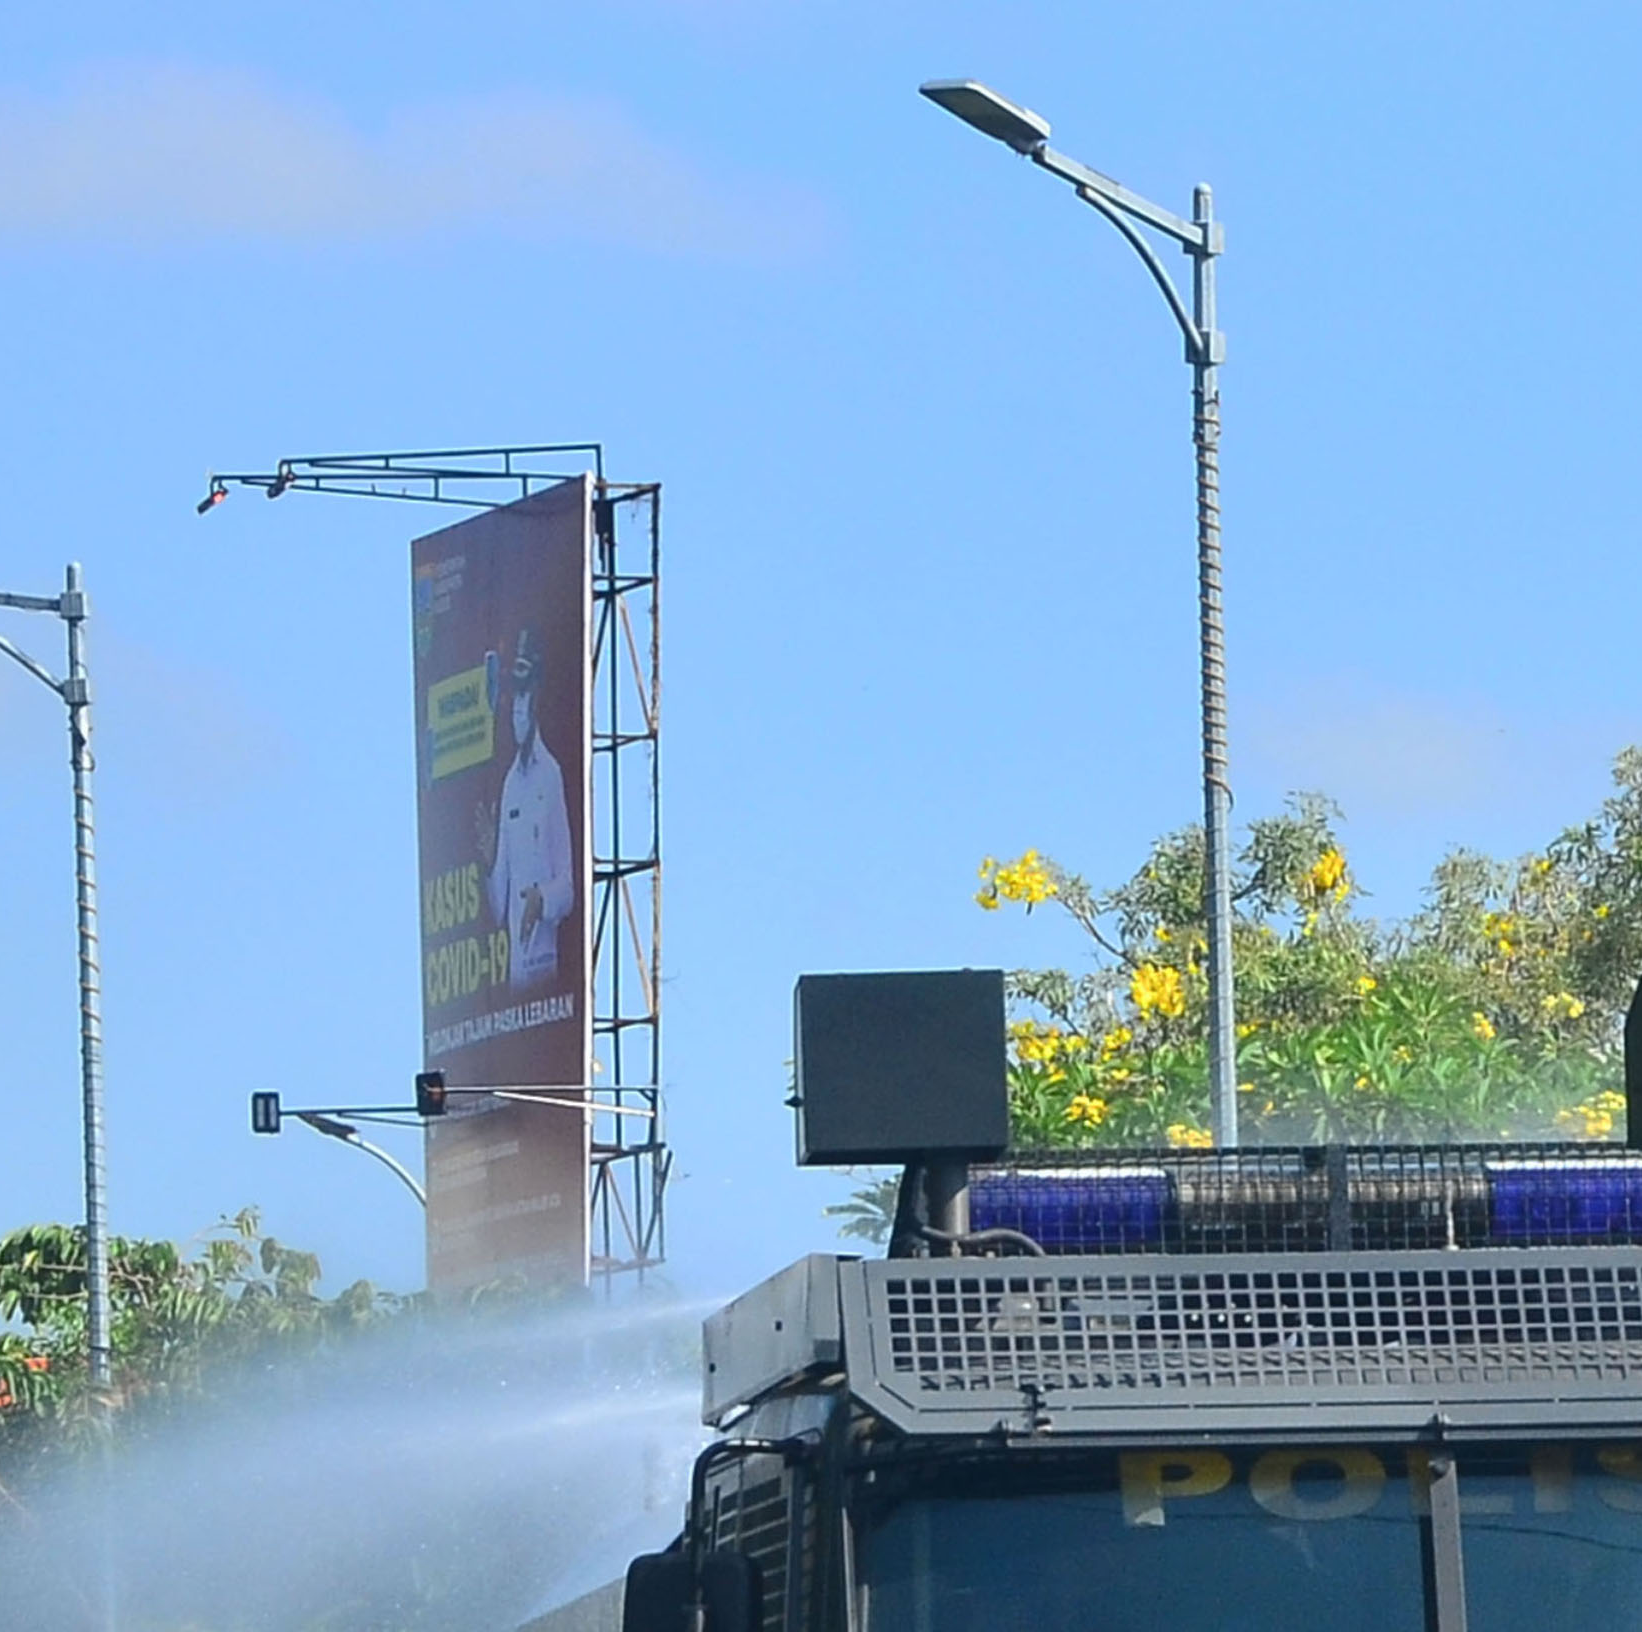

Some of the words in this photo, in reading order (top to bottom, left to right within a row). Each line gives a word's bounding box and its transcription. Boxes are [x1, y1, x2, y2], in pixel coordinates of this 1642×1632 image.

[424, 862, 480, 933] KASUS
[427, 929, 509, 1007] COVID-19
[523, 993, 575, 1027] LEBARAN
